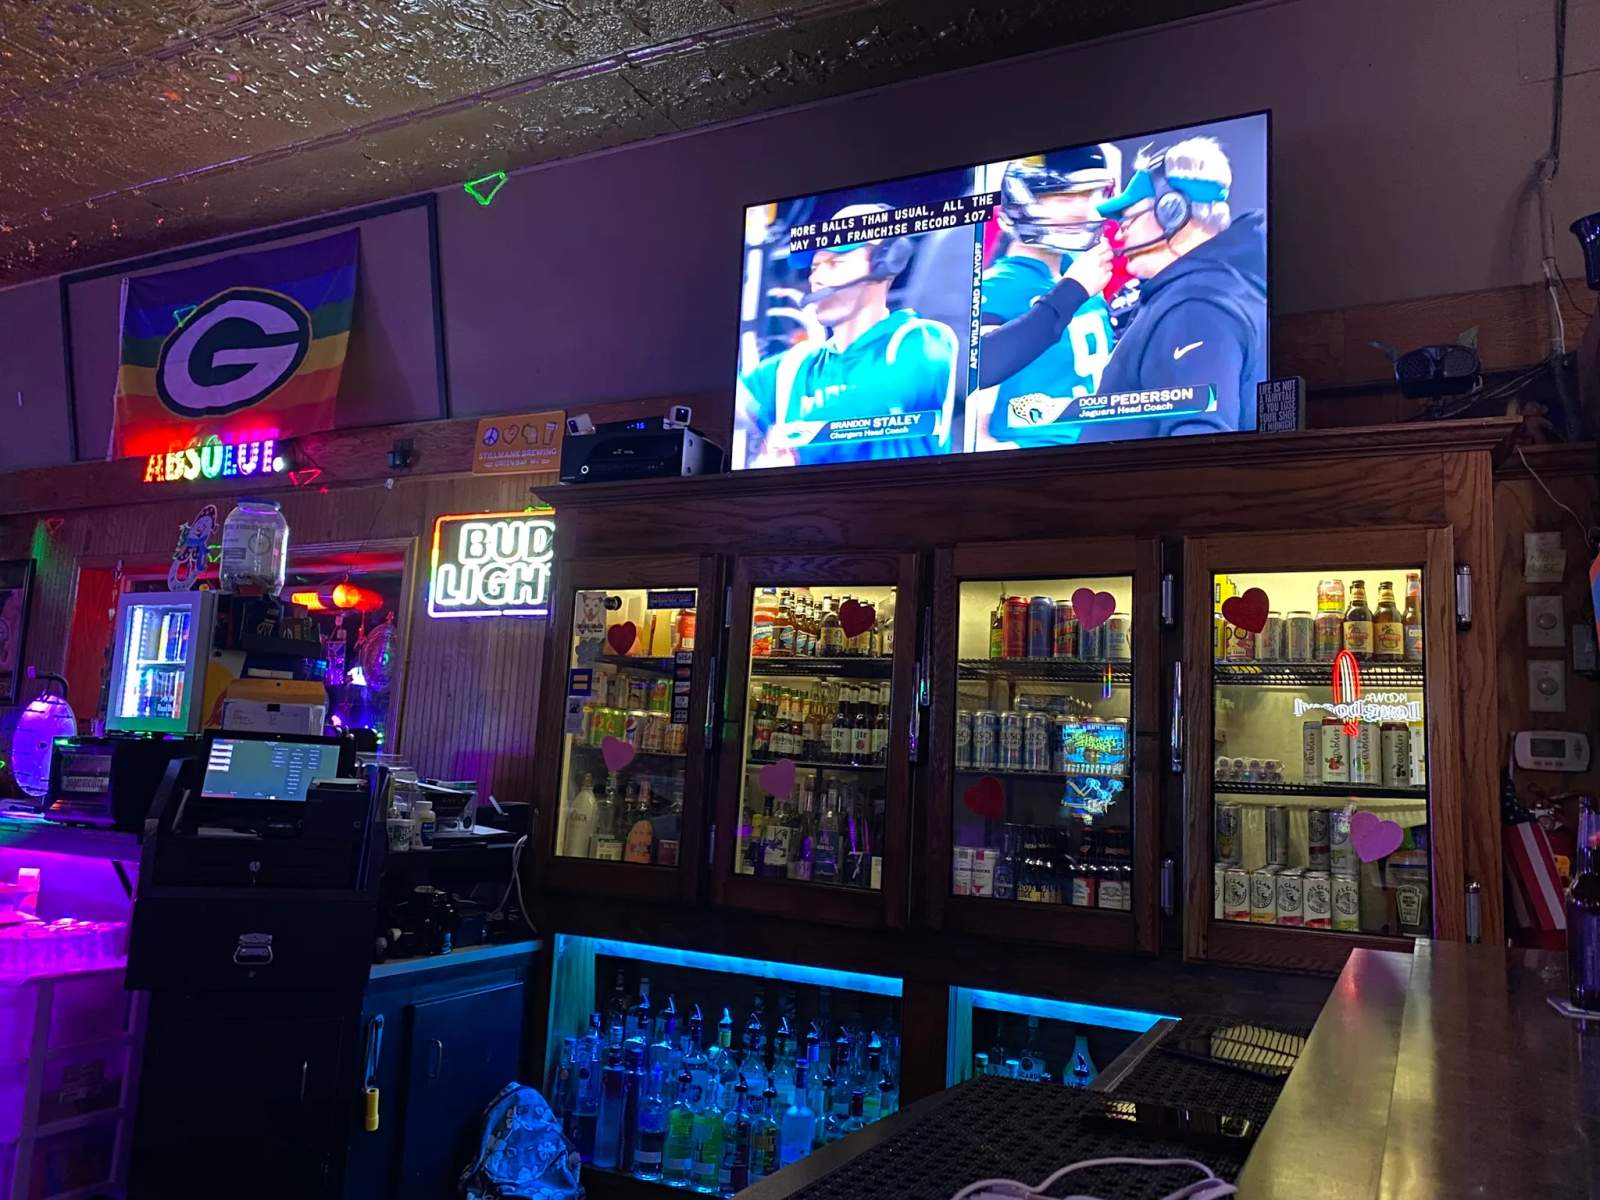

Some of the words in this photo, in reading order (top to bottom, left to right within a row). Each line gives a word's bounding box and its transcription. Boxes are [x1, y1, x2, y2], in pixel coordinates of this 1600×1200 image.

[790, 224, 816, 238] MORE
[822, 219, 854, 233] BALLS
[861, 212, 888, 226] THAN
[894, 204, 935, 221] USUAL,
[943, 199, 964, 212] ALL
[972, 194, 994, 207] THE
[790, 239, 809, 252] WAY
[816, 237, 828, 247] TO
[834, 234, 842, 245] A
[848, 224, 908, 243] FRANCHISE
[914, 214, 957, 231] RECORD
[964, 209, 991, 224] 107.
[973, 242, 983, 286] PLAYOFF
[972, 288, 981, 317] CARD
[970, 319, 980, 347] WILD
[160, 292, 308, 413] G
[970, 348, 979, 369] AFC
[1079, 396, 1107, 407] DOUG
[1110, 388, 1193, 406] PEDERSON
[1259, 383, 1272, 396] LIFE
[1274, 381, 1280, 393] IS
[1283, 379, 1296, 392] NOT
[830, 419, 871, 430] BRANDON
[873, 414, 921, 428] STALEY
[1079, 408, 1115, 418] Jaguars
[1117, 405, 1141, 414] Head
[1143, 402, 1173, 412] Coach
[830, 430, 863, 439] Chargers
[864, 429, 884, 437] Head
[885, 426, 909, 435] Coach
[458, 520, 555, 565] BUD
[436, 562, 551, 606] LIGH
